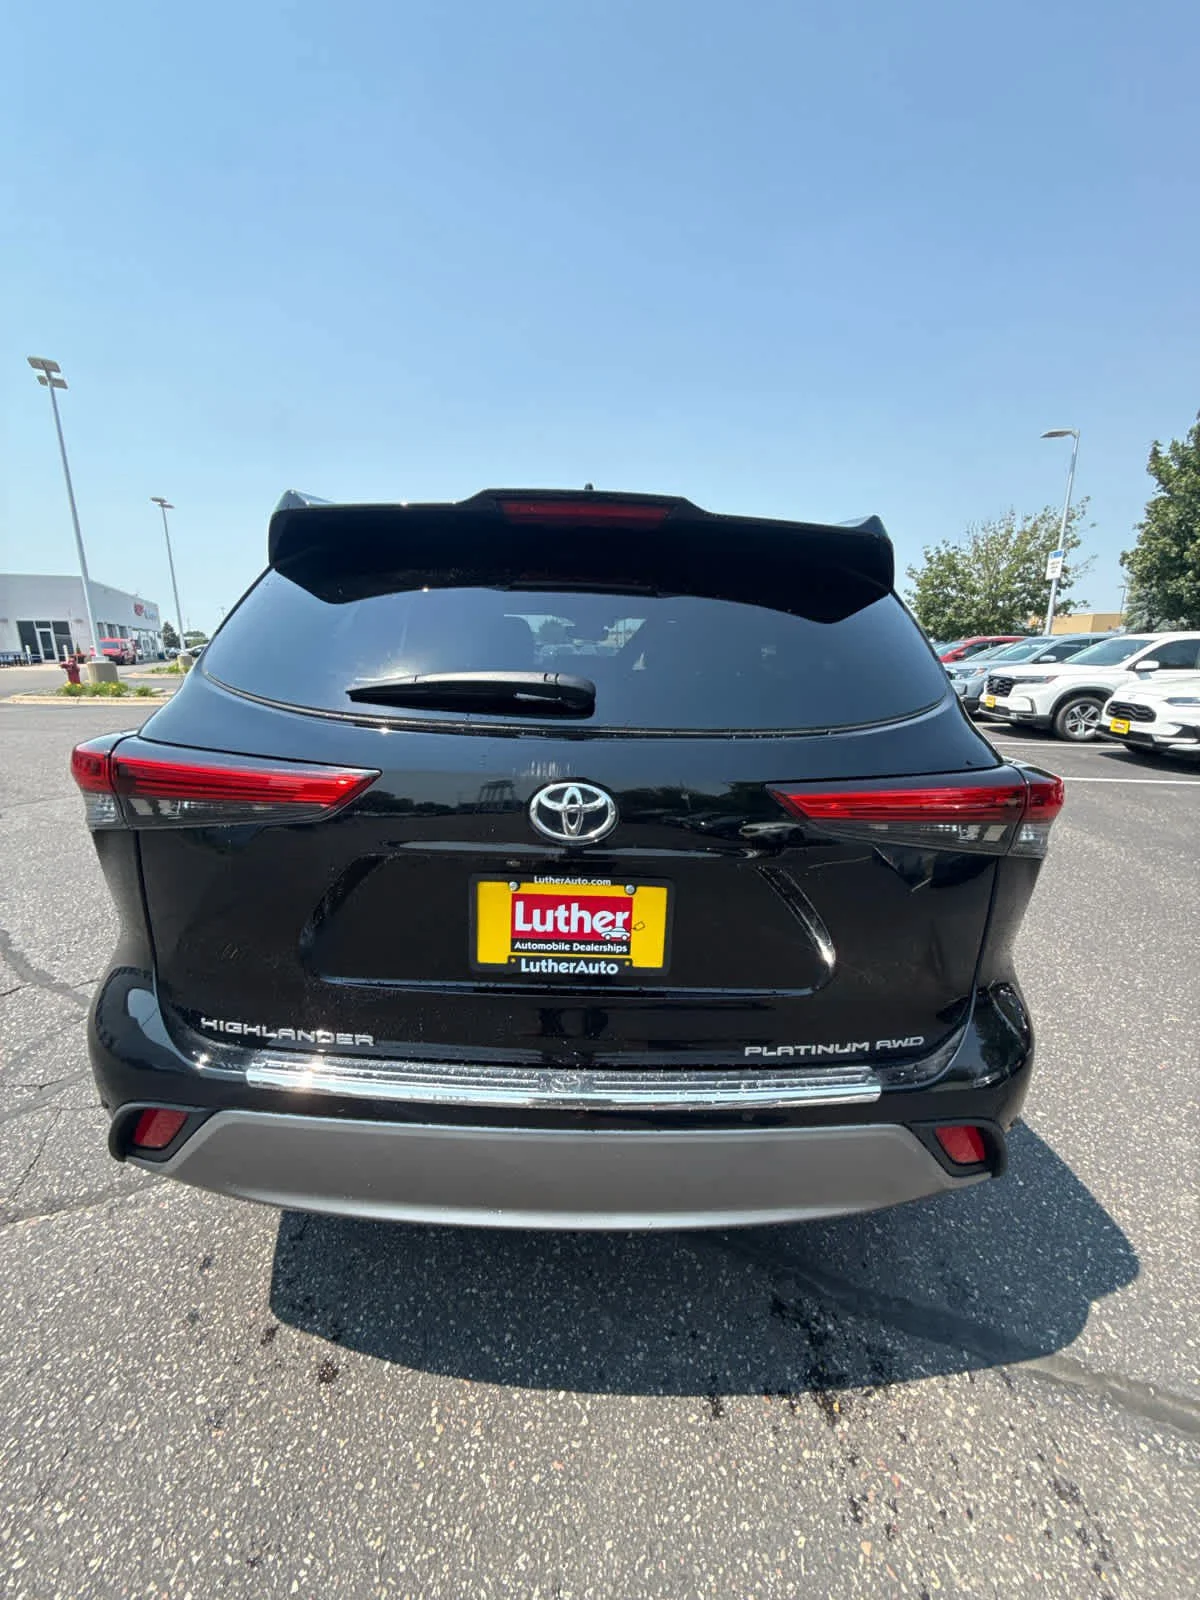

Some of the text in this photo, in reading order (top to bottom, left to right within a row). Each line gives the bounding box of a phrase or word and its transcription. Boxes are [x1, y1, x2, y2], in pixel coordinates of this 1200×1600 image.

[534, 876, 611, 886] LutherAuto.com
[515, 901, 630, 934] Luther
[514, 941, 628, 954] Automobile Dealerships
[521, 958, 619, 975] LutherAuto
[200, 1017, 374, 1047] HIGHLANDER
[744, 1036, 925, 1057] PLATINUM AWD
